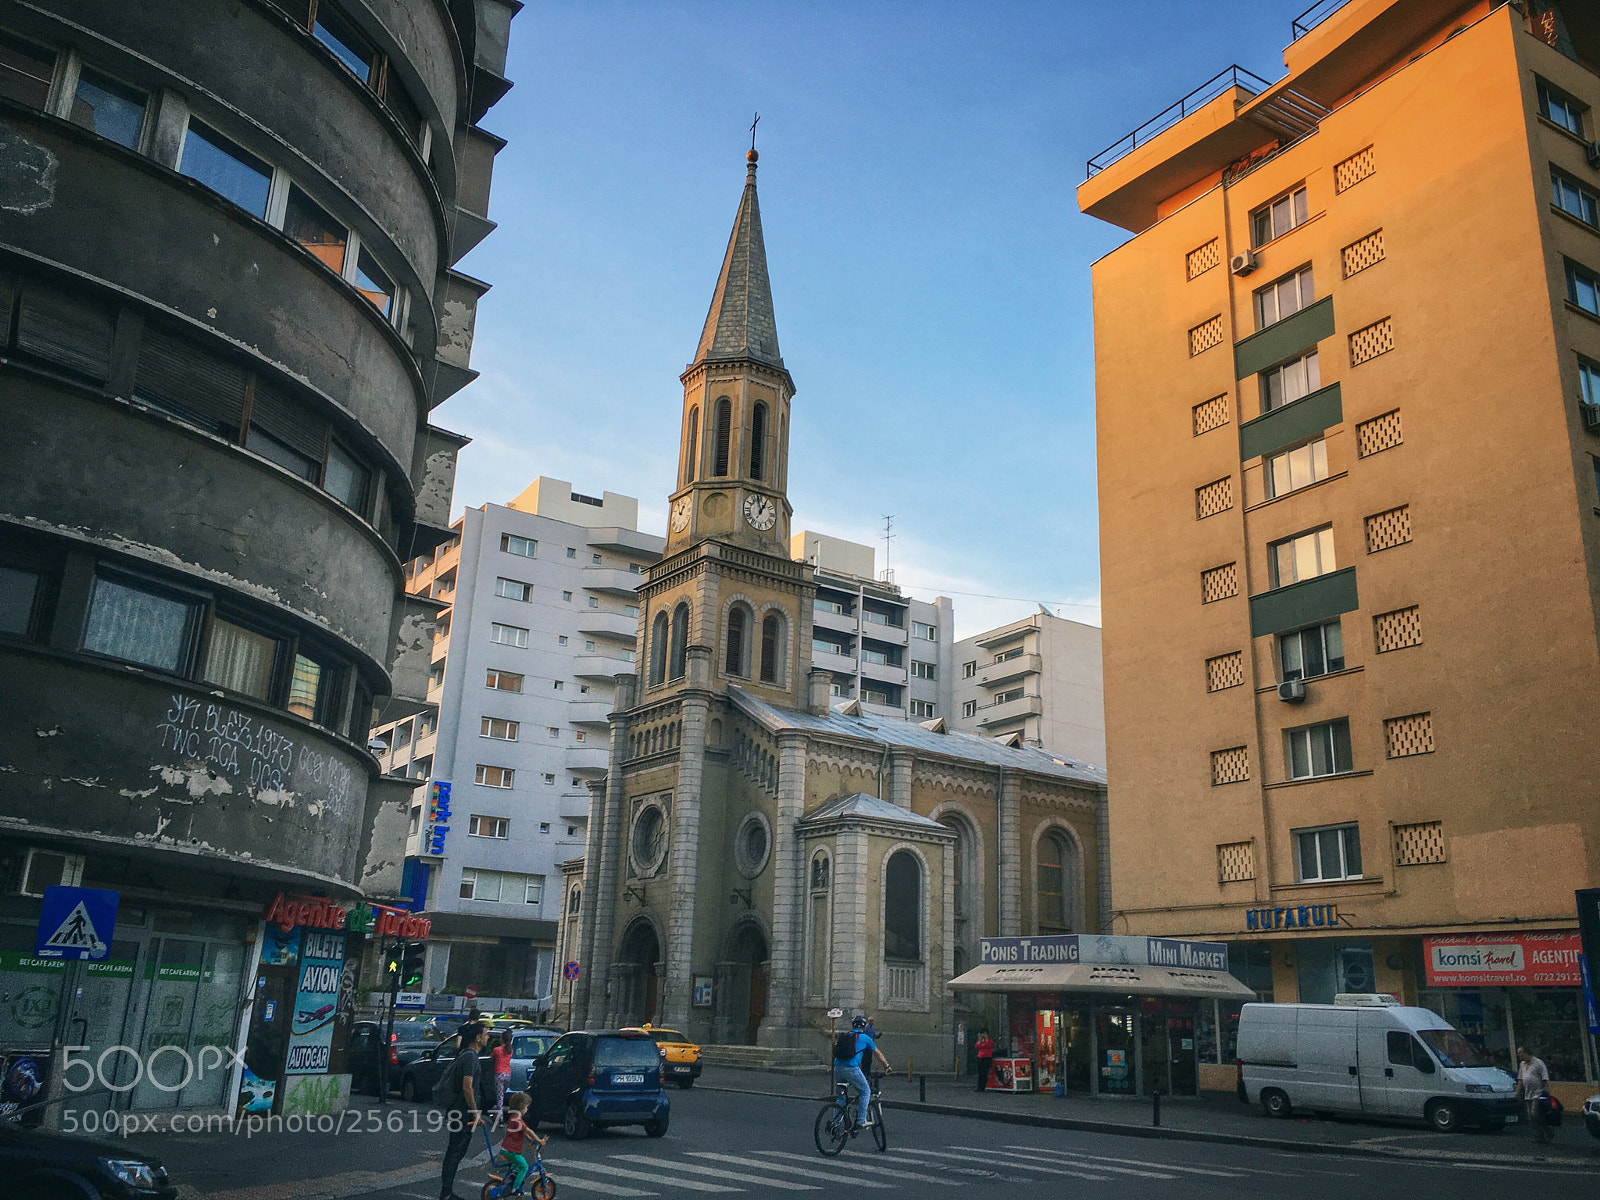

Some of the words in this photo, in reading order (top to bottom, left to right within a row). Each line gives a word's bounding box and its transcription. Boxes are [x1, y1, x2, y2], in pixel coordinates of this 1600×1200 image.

[434, 780, 452, 823] park
[431, 825, 450, 854] inn
[304, 932, 346, 960] BILETE
[981, 941, 1018, 962] PONIS
[1020, 940, 1078, 961] TRADING
[1150, 940, 1178, 965] MINI
[1179, 943, 1226, 969] MARKET
[1438, 948, 1481, 966] komsi
[301, 965, 339, 994] AVION
[1433, 972, 1527, 983] www.komsitravel.ro
[288, 1046, 328, 1069] AUTOCAR
